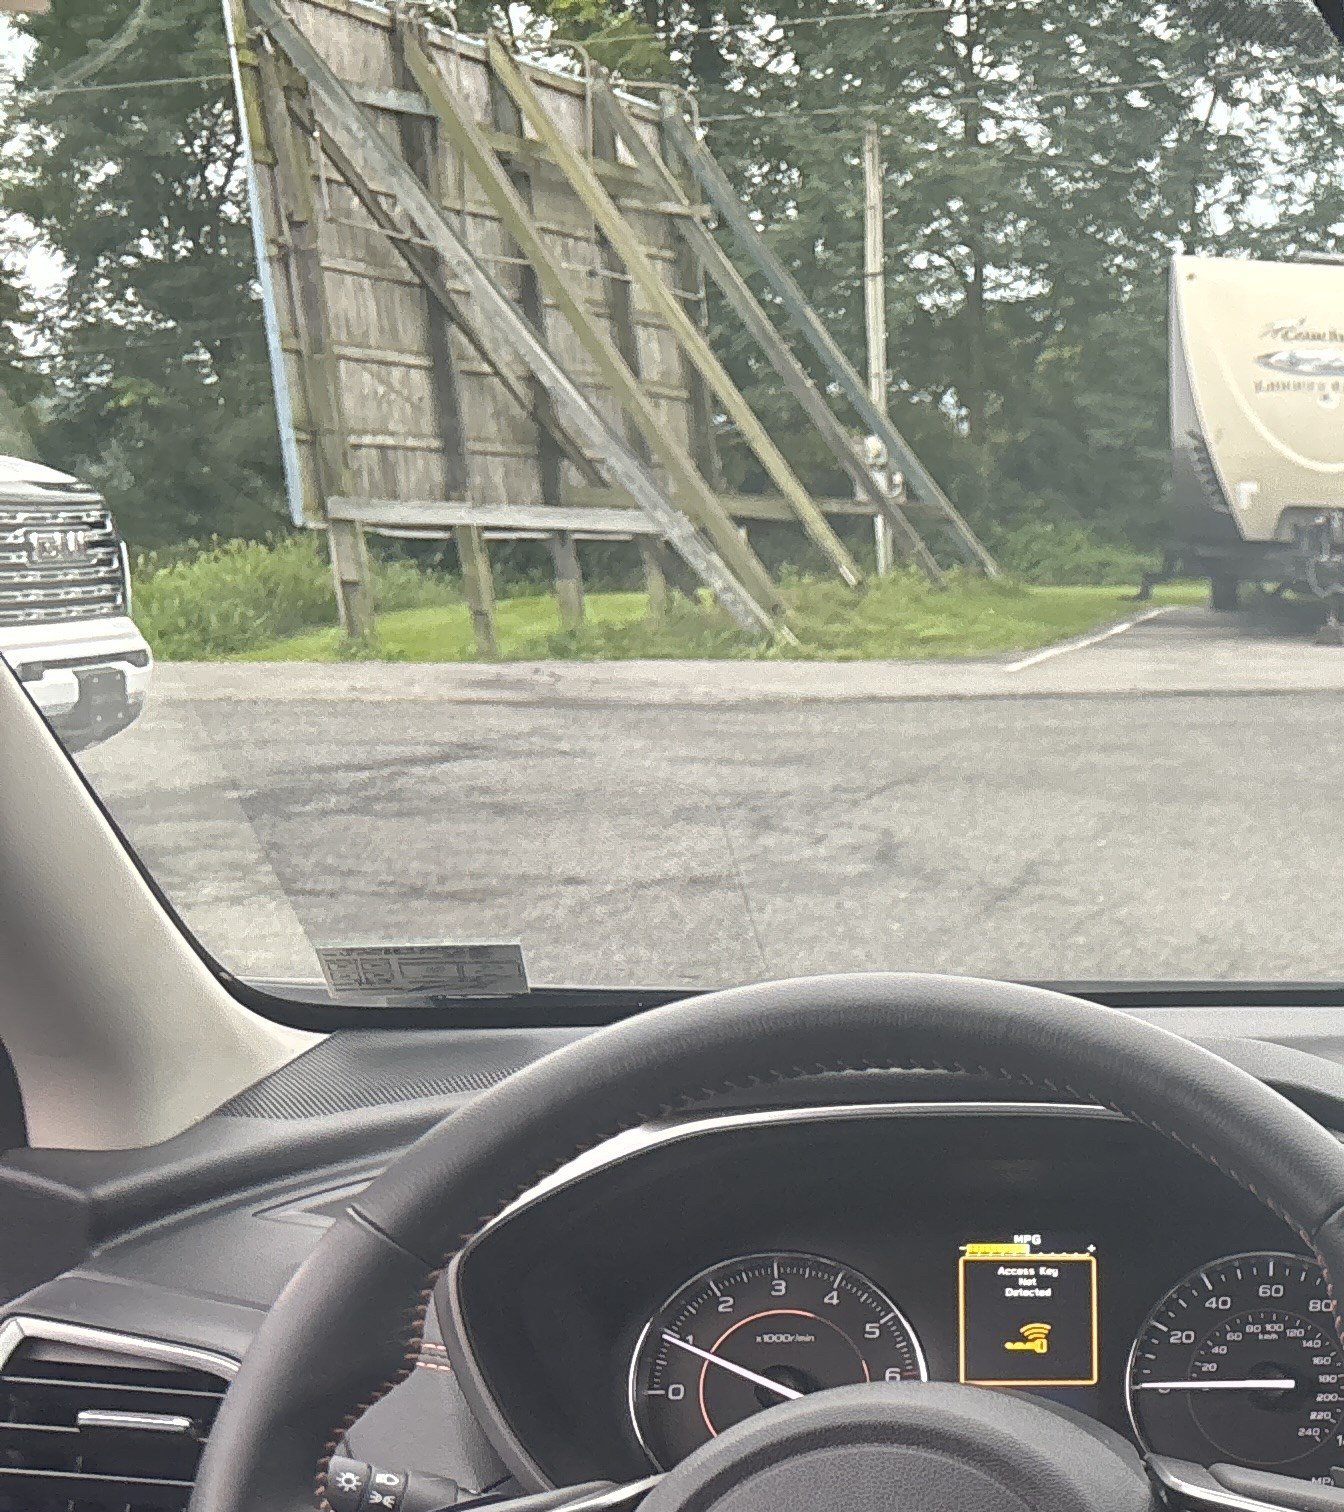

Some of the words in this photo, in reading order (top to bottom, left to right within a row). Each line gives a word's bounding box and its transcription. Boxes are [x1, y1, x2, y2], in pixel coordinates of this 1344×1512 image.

[1013, 1234, 1041, 1245] MPG
[998, 1267, 1035, 1276] Access
[1039, 1267, 1058, 1277] Key
[771, 1279, 787, 1296] 3
[1018, 1277, 1037, 1286] Not
[1005, 1287, 1051, 1297] Detected
[1258, 1284, 1284, 1298] 60
[823, 1290, 840, 1306] 4
[1204, 1296, 1231, 1310] 40
[717, 1297, 734, 1312] 2
[1309, 1300, 1334, 1313] 80
[864, 1323, 881, 1338] 5
[1169, 1330, 1195, 1344] 20
[1211, 1345, 1228, 1354] 40
[1302, 1339, 1322, 1348] 140
[1201, 1362, 1217, 1372] 20
[885, 1368, 901, 1382] 6
[668, 1384, 685, 1400] 0
[1316, 1393, 1339, 1402] 200
[1309, 1411, 1332, 1420] 220
[1298, 1428, 1320, 1437] 240
